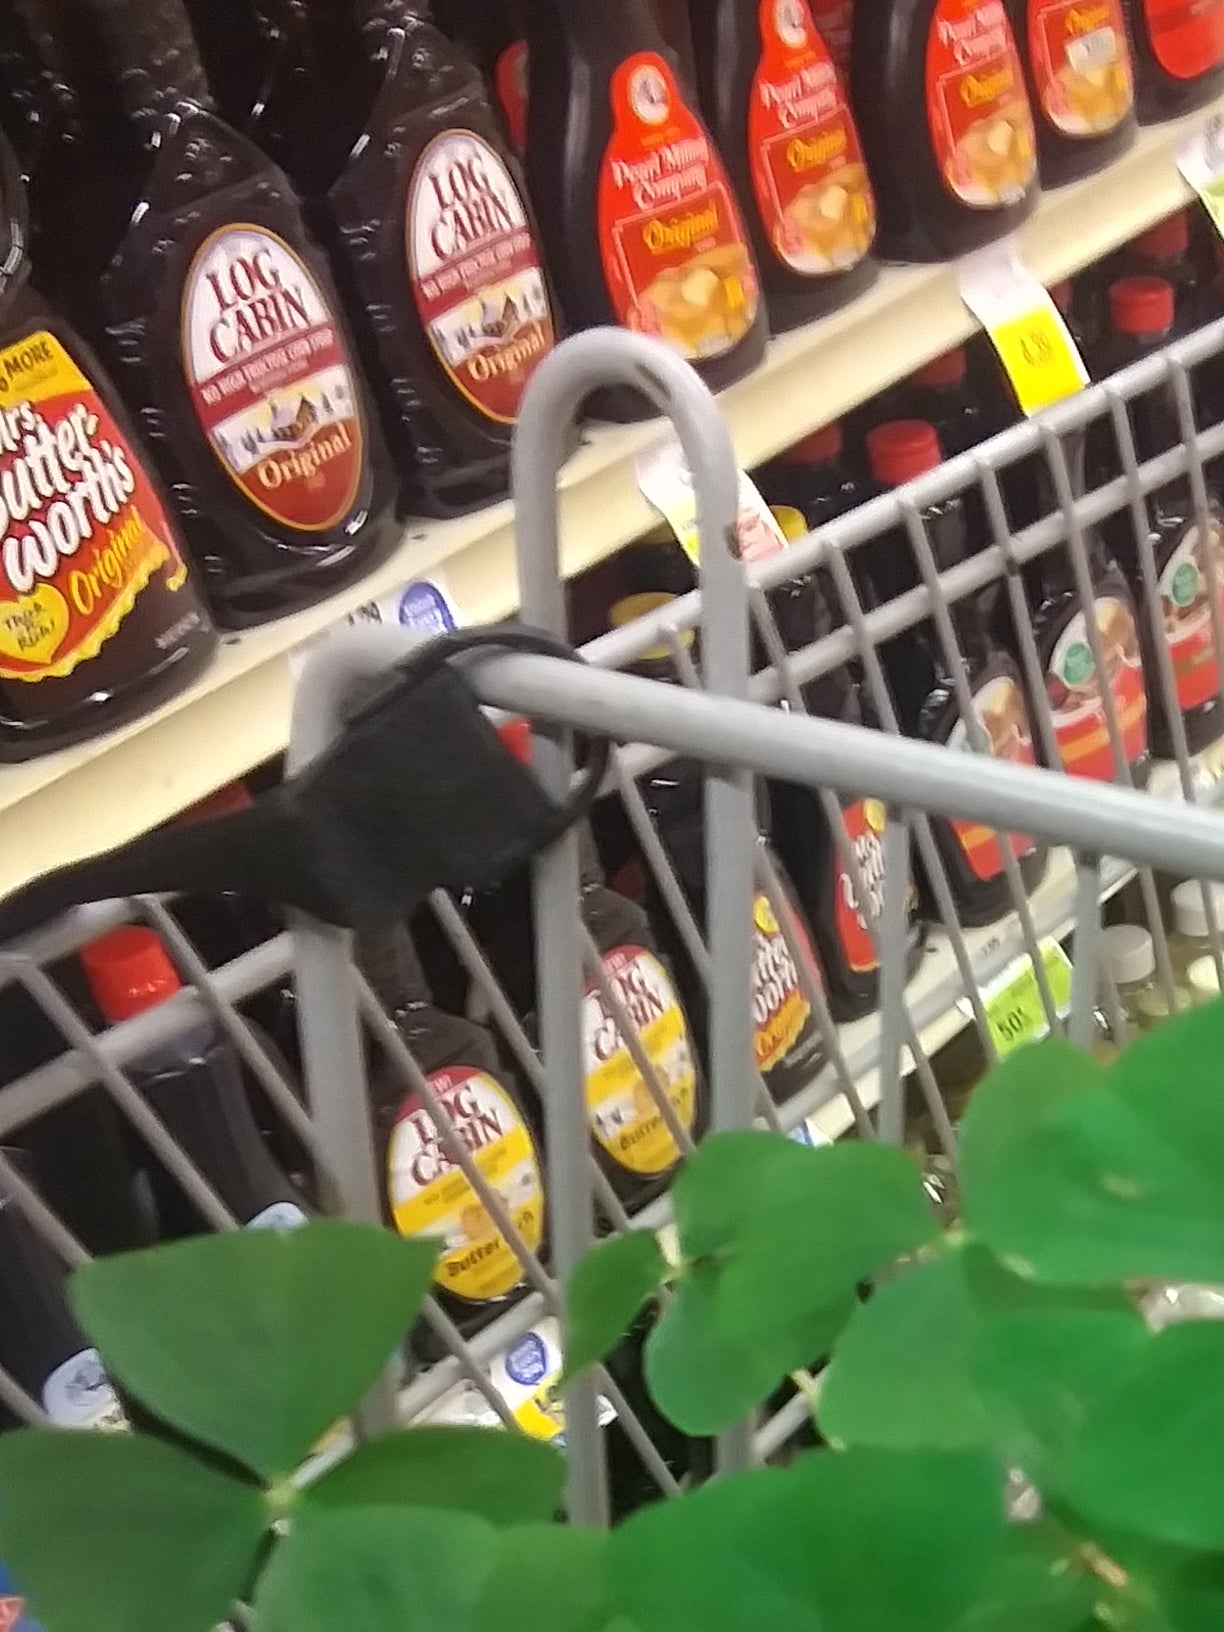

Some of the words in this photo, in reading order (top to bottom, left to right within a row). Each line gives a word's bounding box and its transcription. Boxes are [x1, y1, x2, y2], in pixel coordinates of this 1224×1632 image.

[428, 150, 492, 210] LOG
[431, 190, 515, 261] CABIN
[206, 250, 281, 312] LOG
[209, 286, 311, 363] CABIN
[467, 322, 546, 381] Original
[3, 341, 55, 381] MORE
[257, 422, 352, 489] Original
[68, 504, 143, 616] Original
